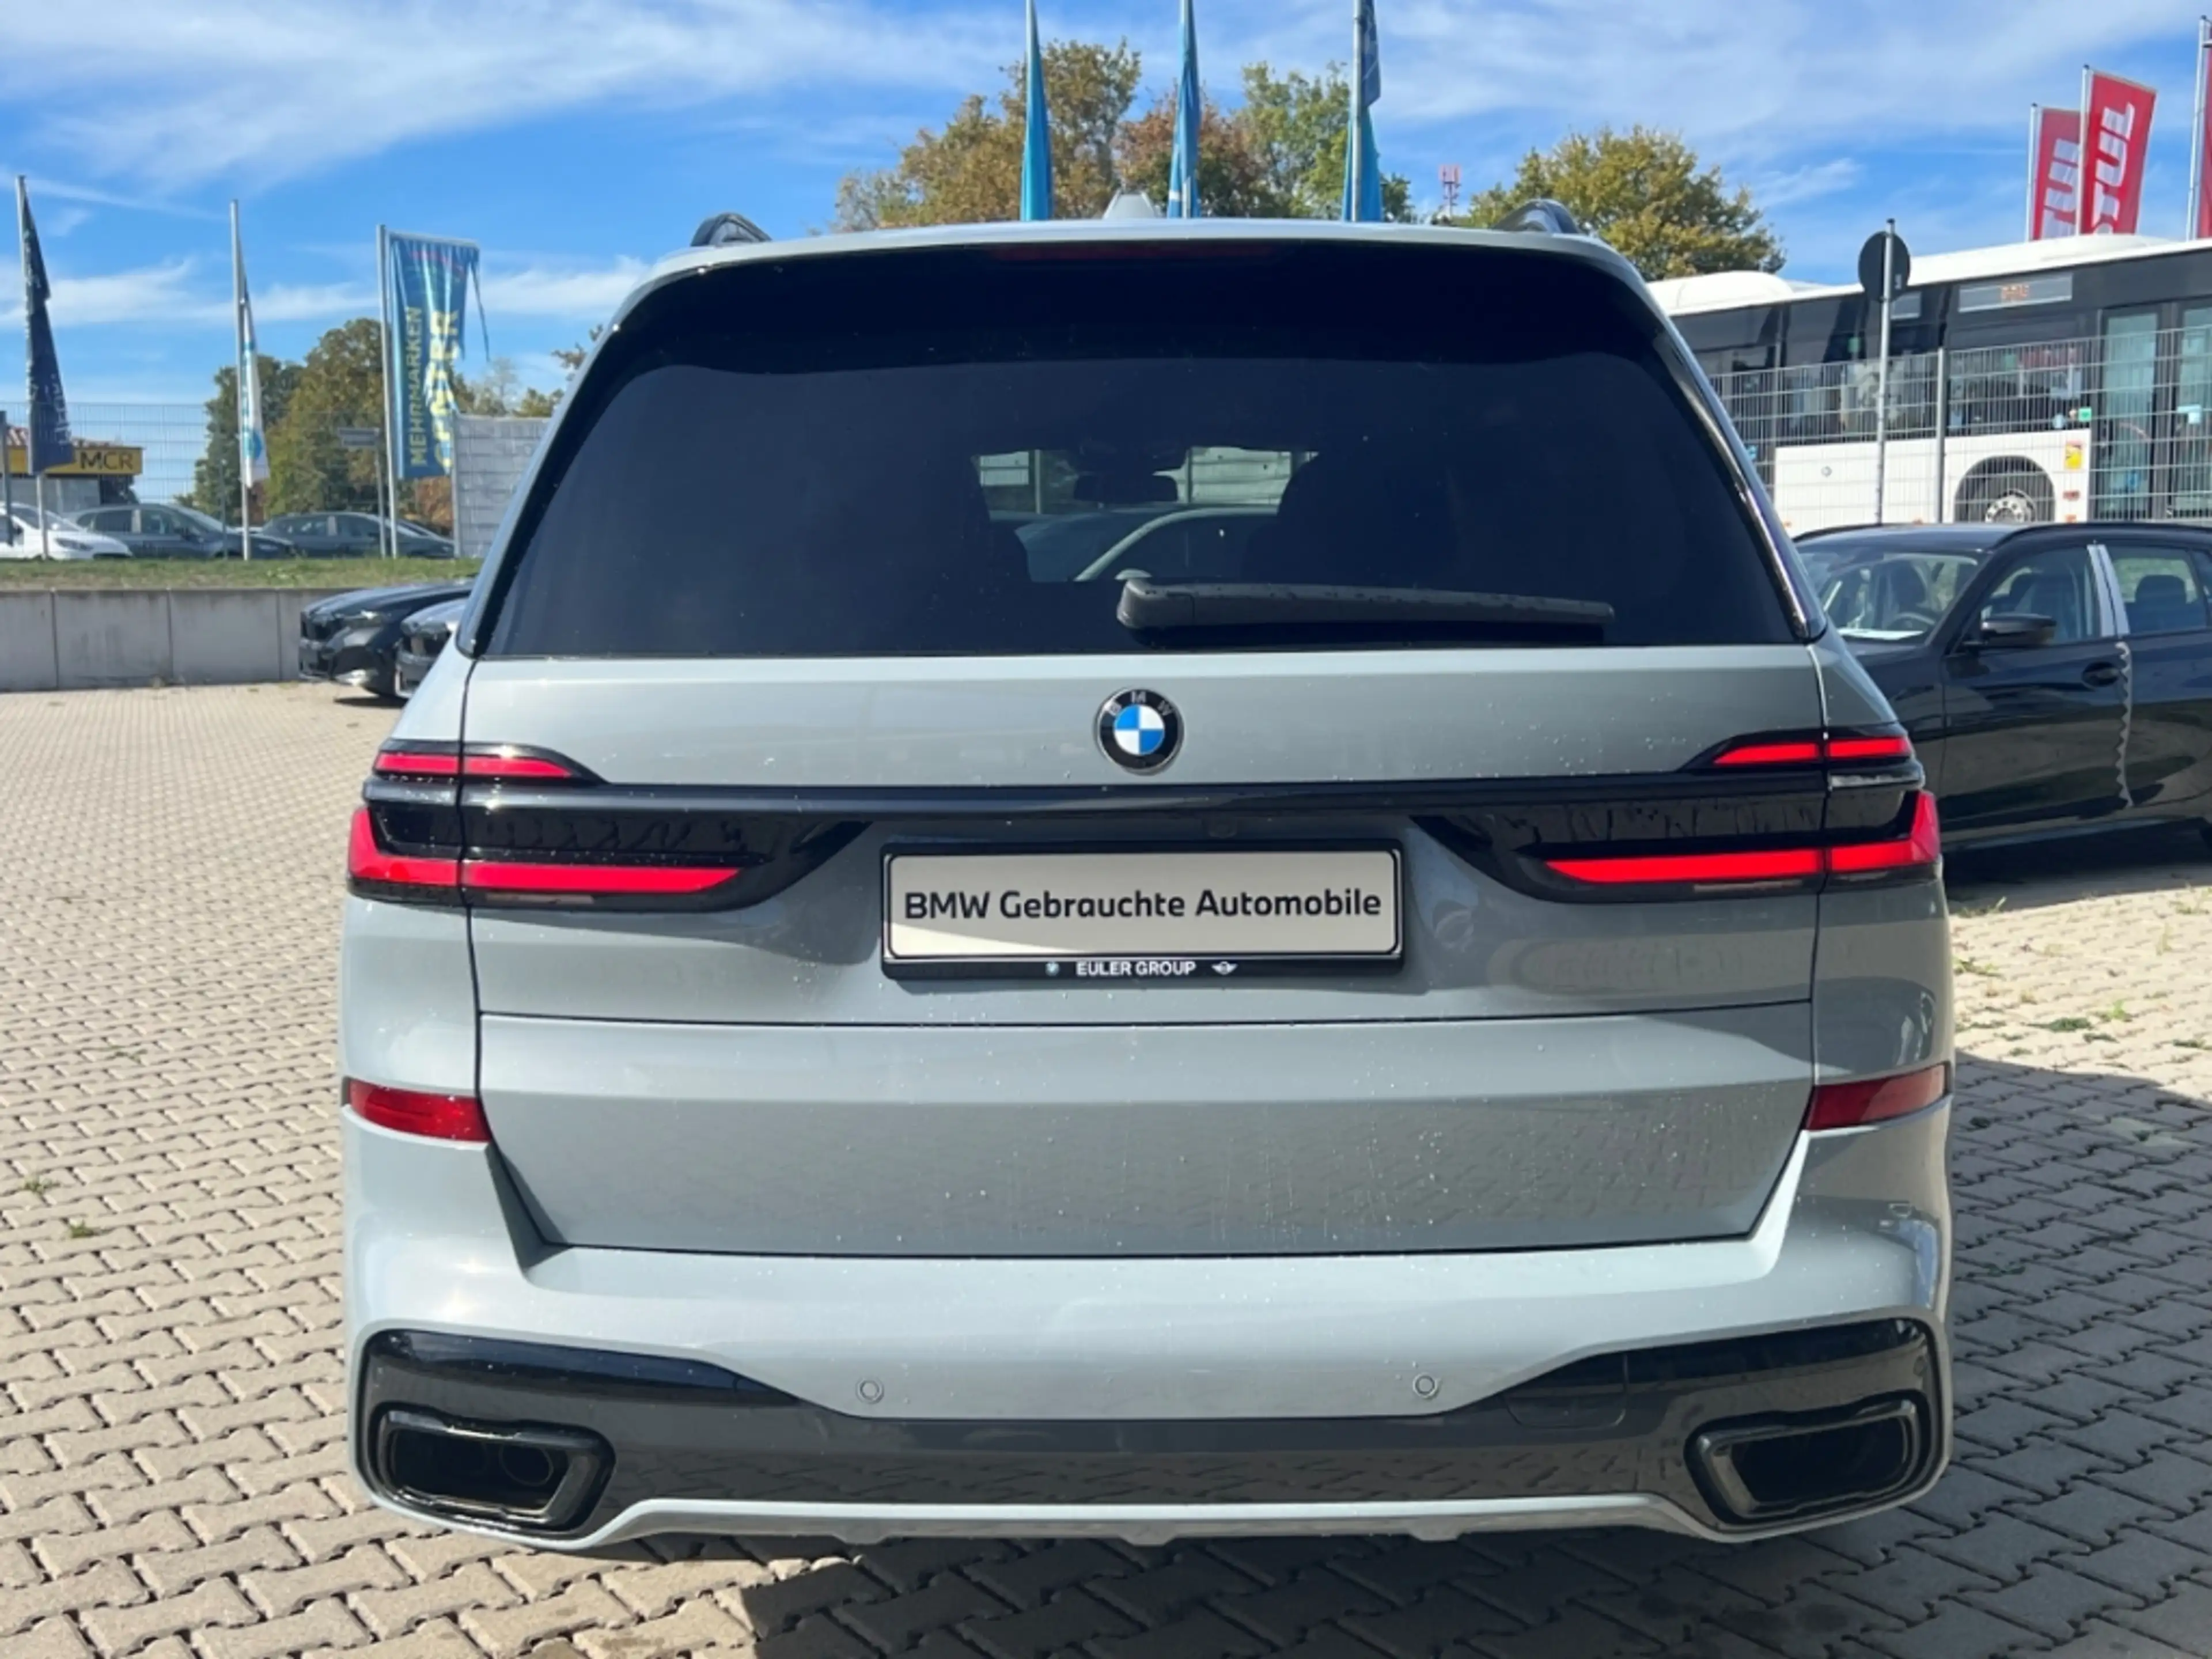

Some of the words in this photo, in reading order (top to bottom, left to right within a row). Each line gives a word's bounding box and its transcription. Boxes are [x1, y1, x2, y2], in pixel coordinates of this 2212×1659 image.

[405, 306, 428, 467] MEHRMARKEN
[79, 451, 134, 470] MCR
[1104, 691, 1173, 717] BMW
[905, 891, 990, 919] BMW
[1000, 889, 1185, 918] Gebrauchte
[1195, 888, 1381, 916] Automobile
[1075, 961, 1132, 976] EULER
[1135, 960, 1196, 976] GROUP
